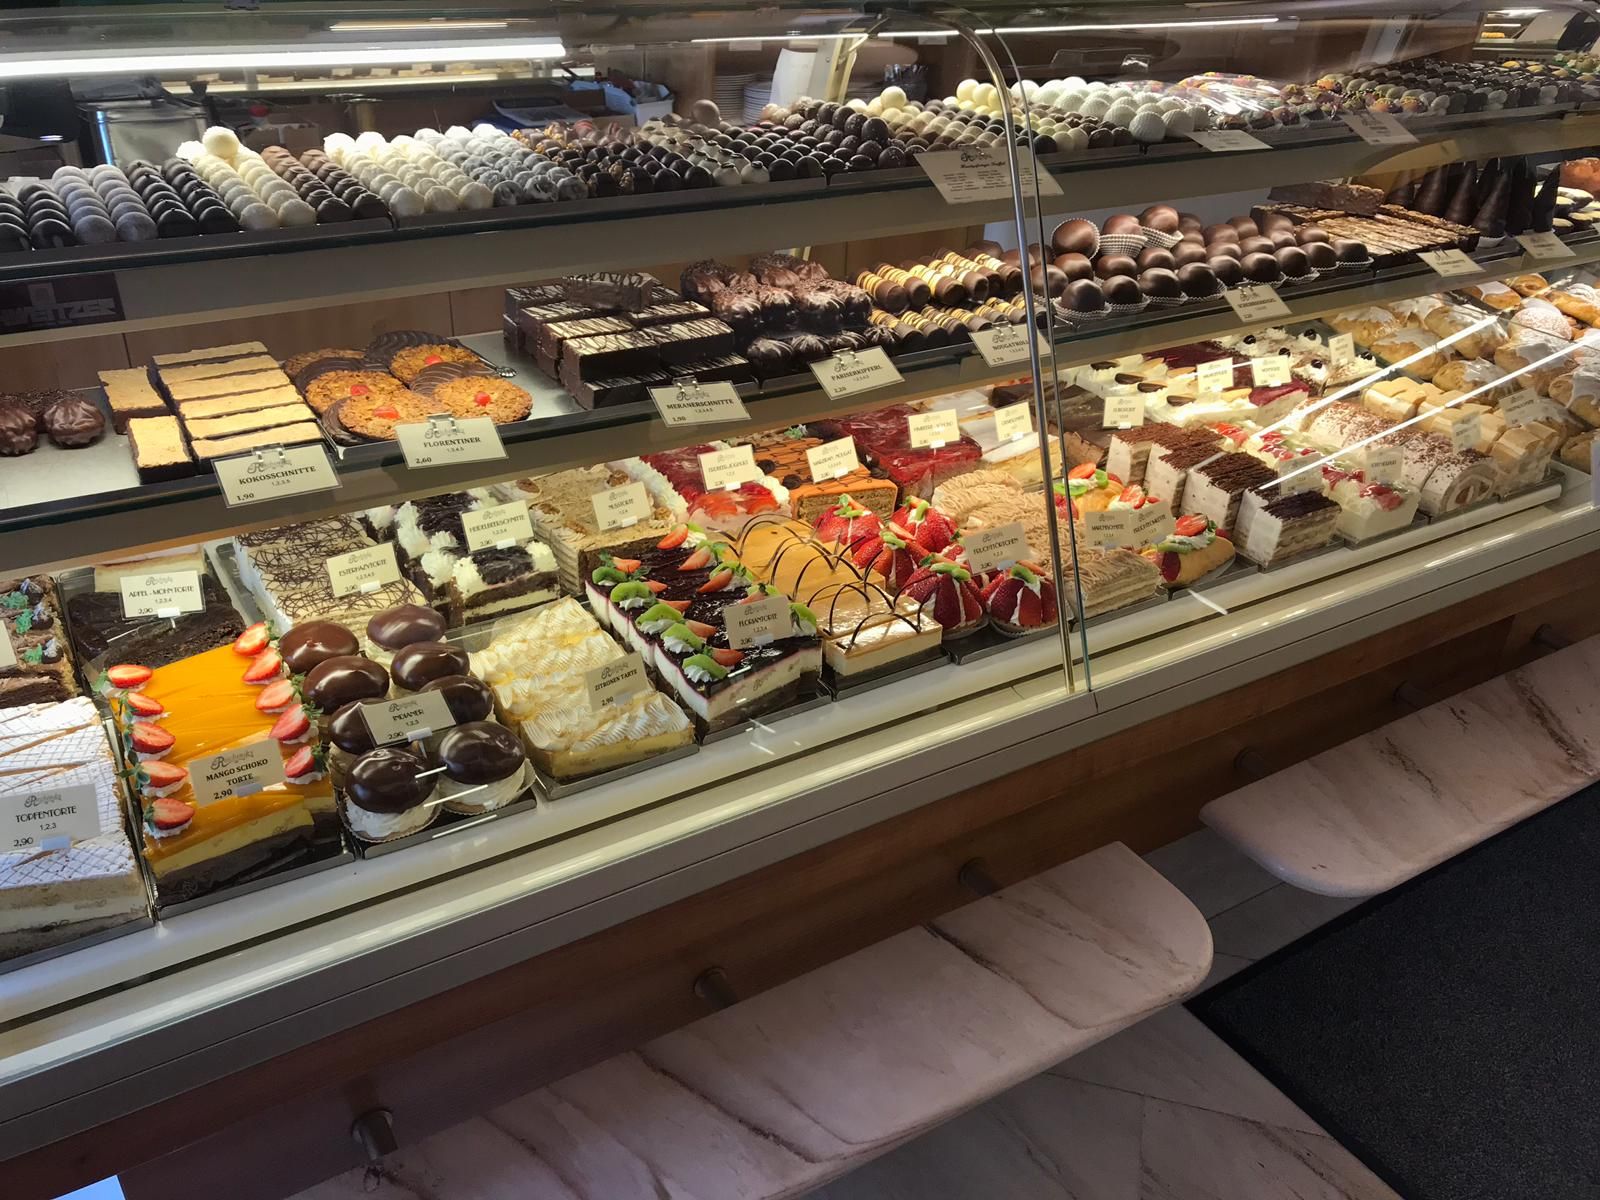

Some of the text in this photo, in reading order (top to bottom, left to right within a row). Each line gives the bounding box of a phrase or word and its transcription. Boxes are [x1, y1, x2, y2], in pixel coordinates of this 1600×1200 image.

[831, 364, 882, 381] PARISERKIPFERL
[666, 398, 734, 409] MERANERSCHNITTE
[423, 436, 481, 448] FLORENTINER
[415, 456, 432, 464] 2,60
[239, 465, 316, 485] KOKOSSCHNITTE
[236, 492, 255, 501] 1,90
[595, 675, 620, 691] ZITRONEN
[621, 669, 637, 680] TARTE
[388, 731, 404, 739] 2,90
[206, 768, 235, 782] MANGO
[237, 758, 268, 772] SCHOKO
[226, 773, 253, 786] TORTE
[213, 788, 233, 800] 2,90
[15, 805, 77, 823] TOPFENTORTE
[13, 837, 34, 847] 2,90
